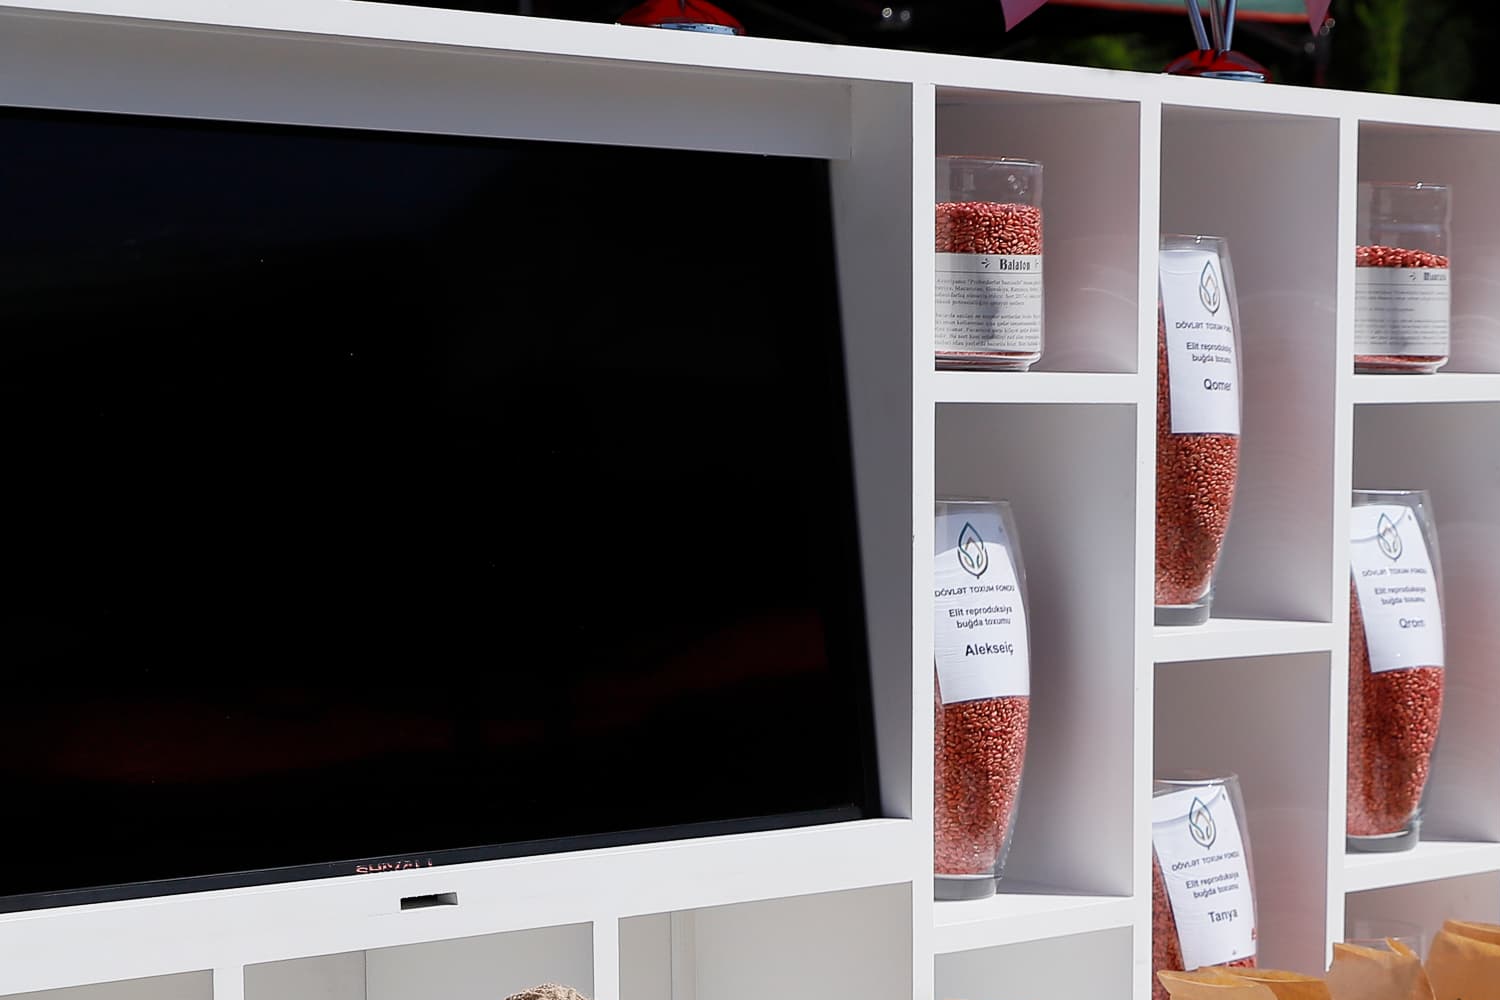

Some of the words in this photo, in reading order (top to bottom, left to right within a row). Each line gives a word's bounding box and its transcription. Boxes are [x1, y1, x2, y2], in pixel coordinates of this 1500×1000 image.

[1000, 259, 1030, 271] Balaton
[935, 586, 967, 597] DÖVLƏT
[949, 608, 964, 617] Elit
[957, 619, 983, 629] buğda
[965, 641, 1014, 657] Alekseiç
[1208, 909, 1238, 922] Tanya
